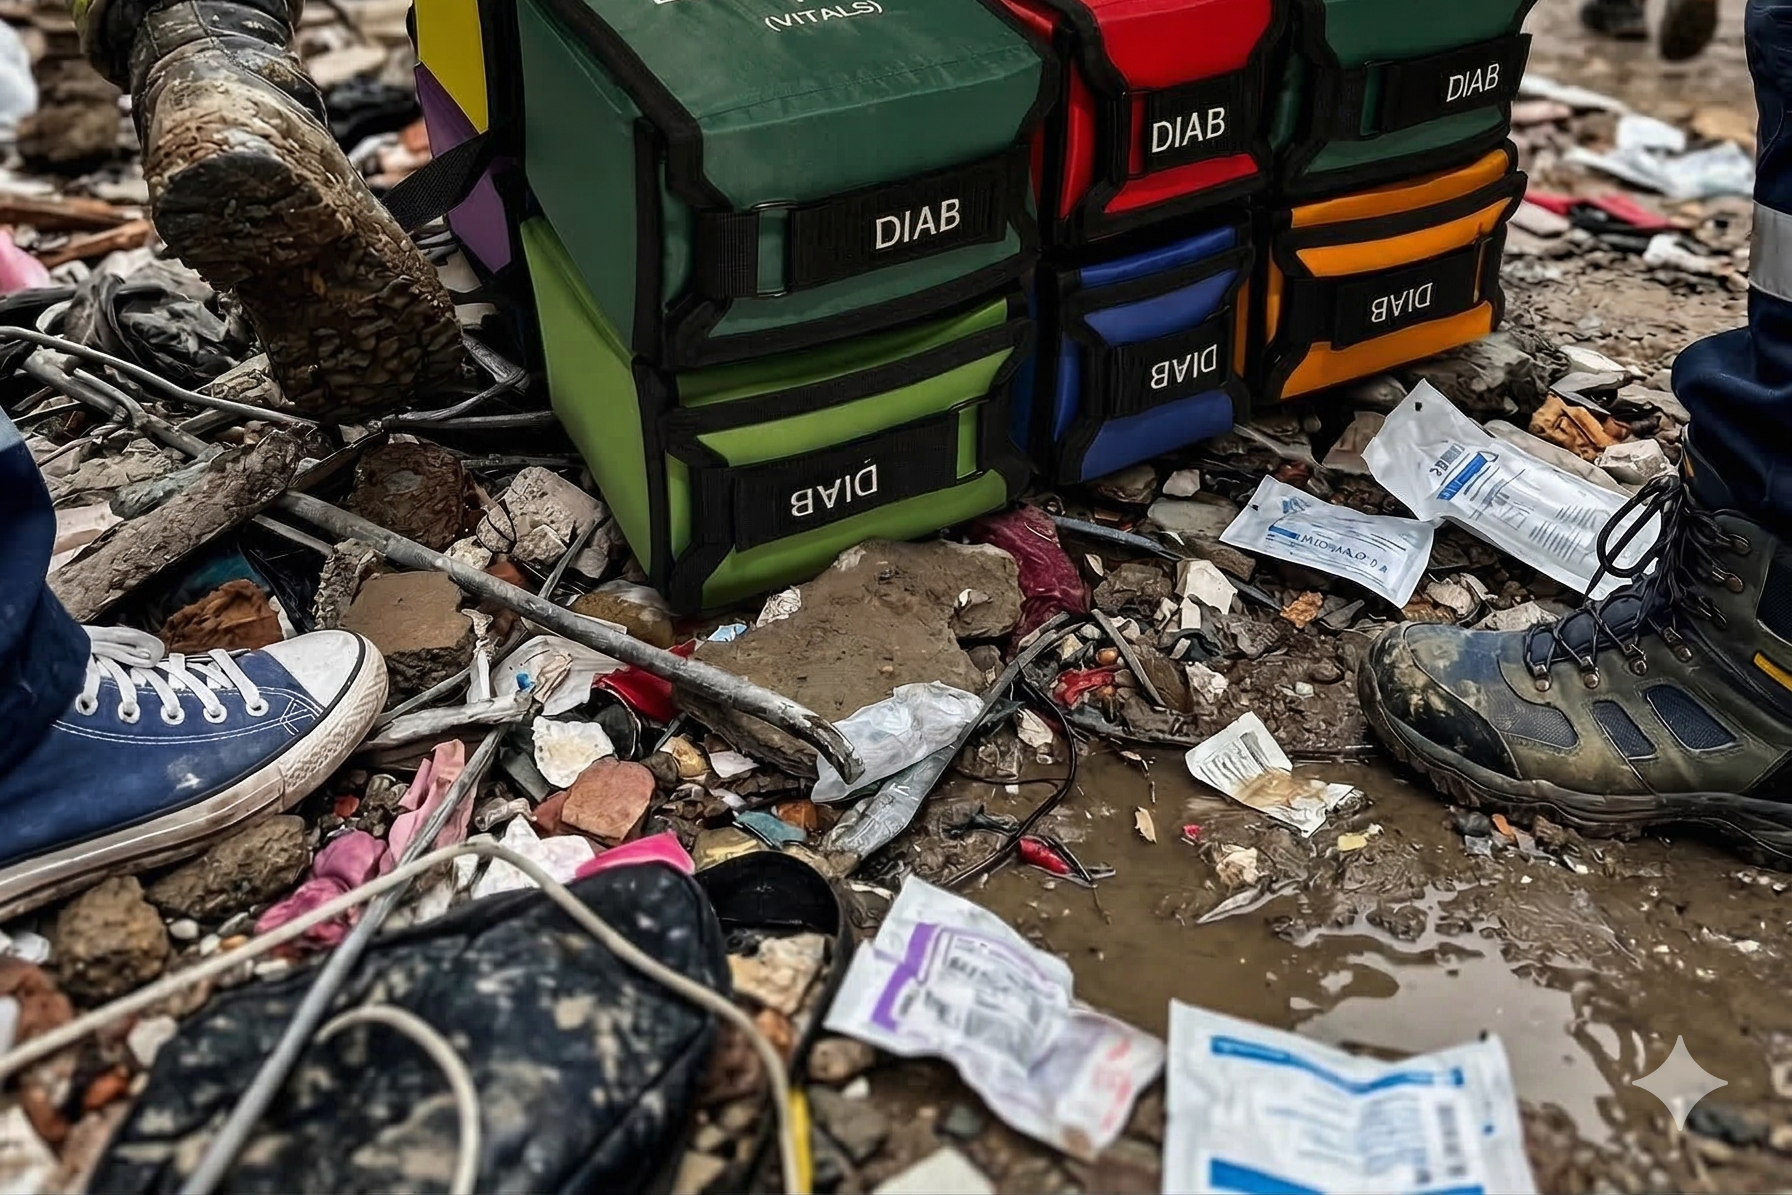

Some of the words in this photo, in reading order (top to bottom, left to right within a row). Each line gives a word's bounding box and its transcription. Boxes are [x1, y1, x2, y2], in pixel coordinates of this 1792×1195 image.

[764, 0, 883, 32] (VITALS)
[1446, 63, 1500, 103] DIAB
[1151, 107, 1225, 153] DIAB
[875, 198, 960, 250] DIAB
[1371, 282, 1433, 323] DIAB
[1150, 343, 1219, 390] DIAB
[790, 463, 878, 517] DIAB
